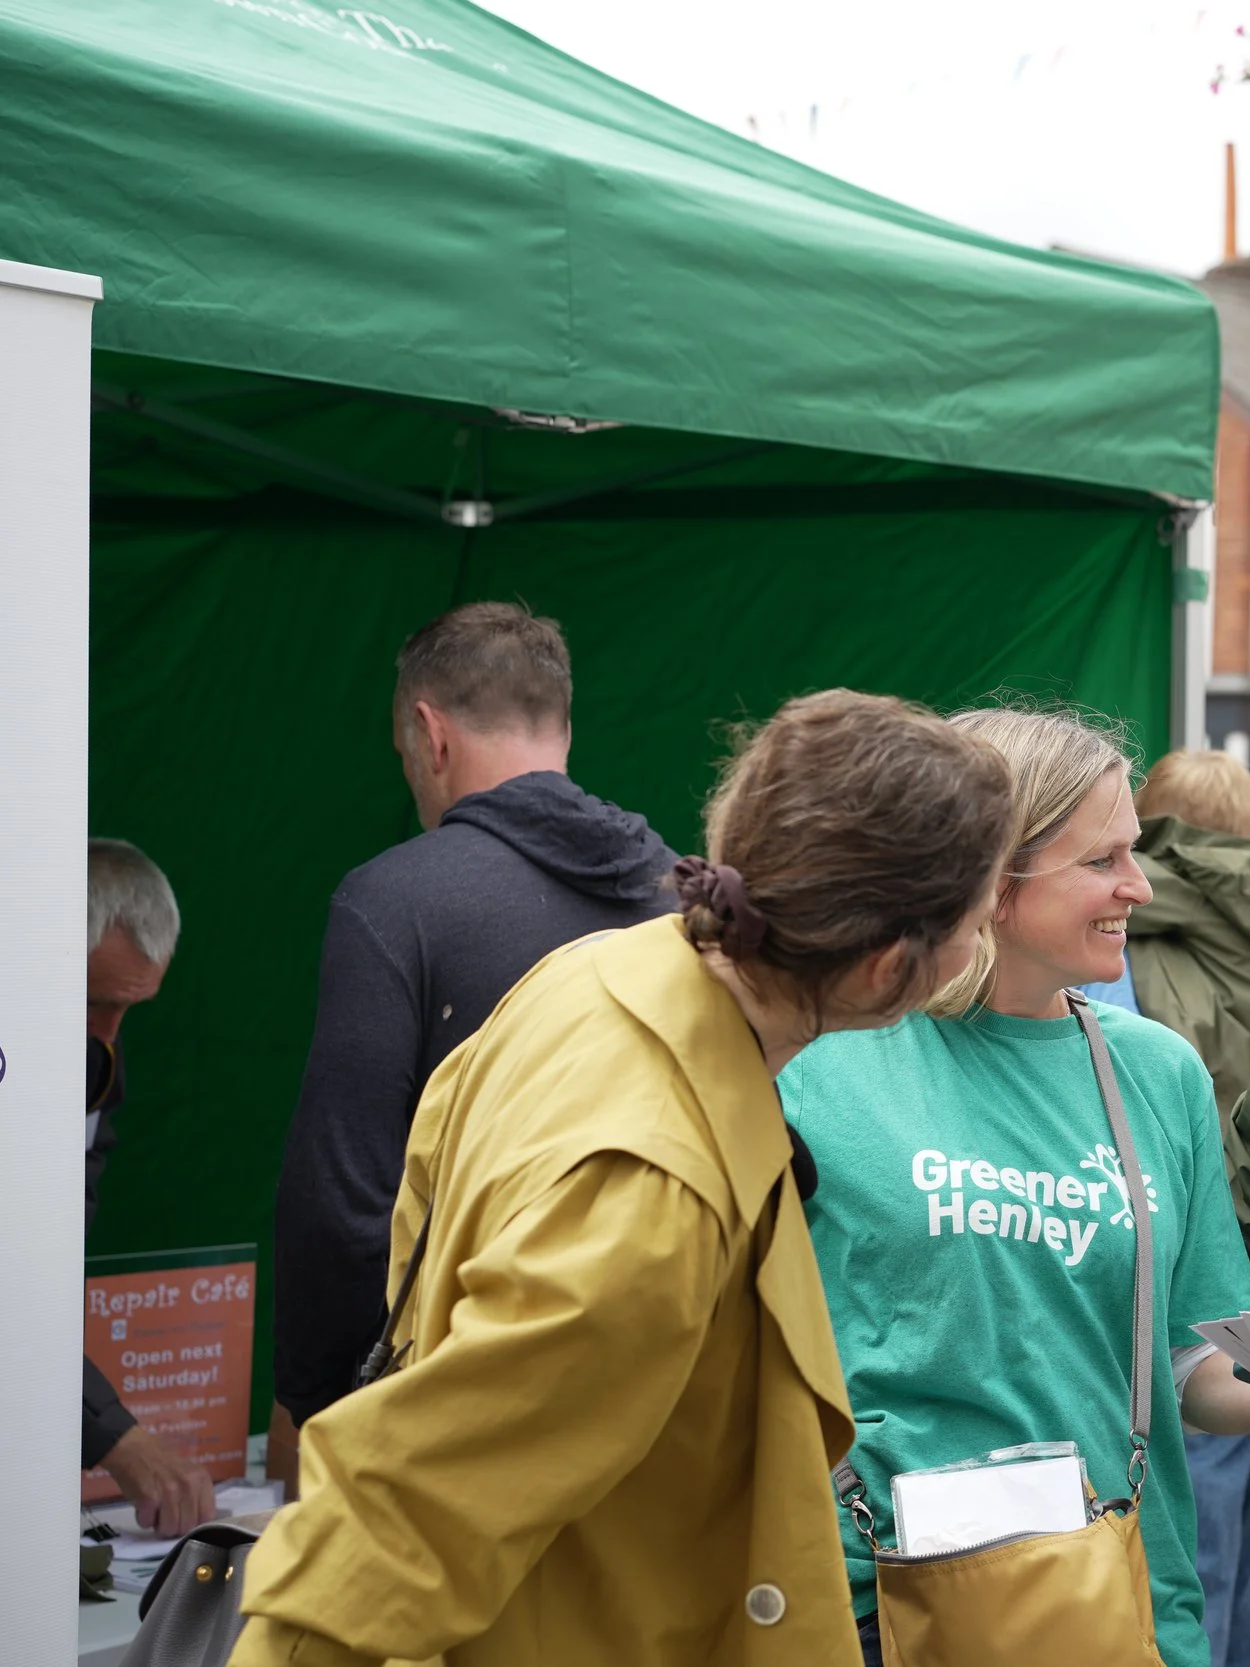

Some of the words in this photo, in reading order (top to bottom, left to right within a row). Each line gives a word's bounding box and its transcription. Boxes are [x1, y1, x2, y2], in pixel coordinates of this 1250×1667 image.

[911, 1149, 1108, 1212] Greener
[927, 1191, 1099, 1266] Henley
[89, 1283, 181, 1318] Repair
[191, 1273, 250, 1305] Café
[121, 1350, 174, 1369] Open
[180, 1343, 223, 1361] next
[122, 1365, 219, 1393] Saturday!
